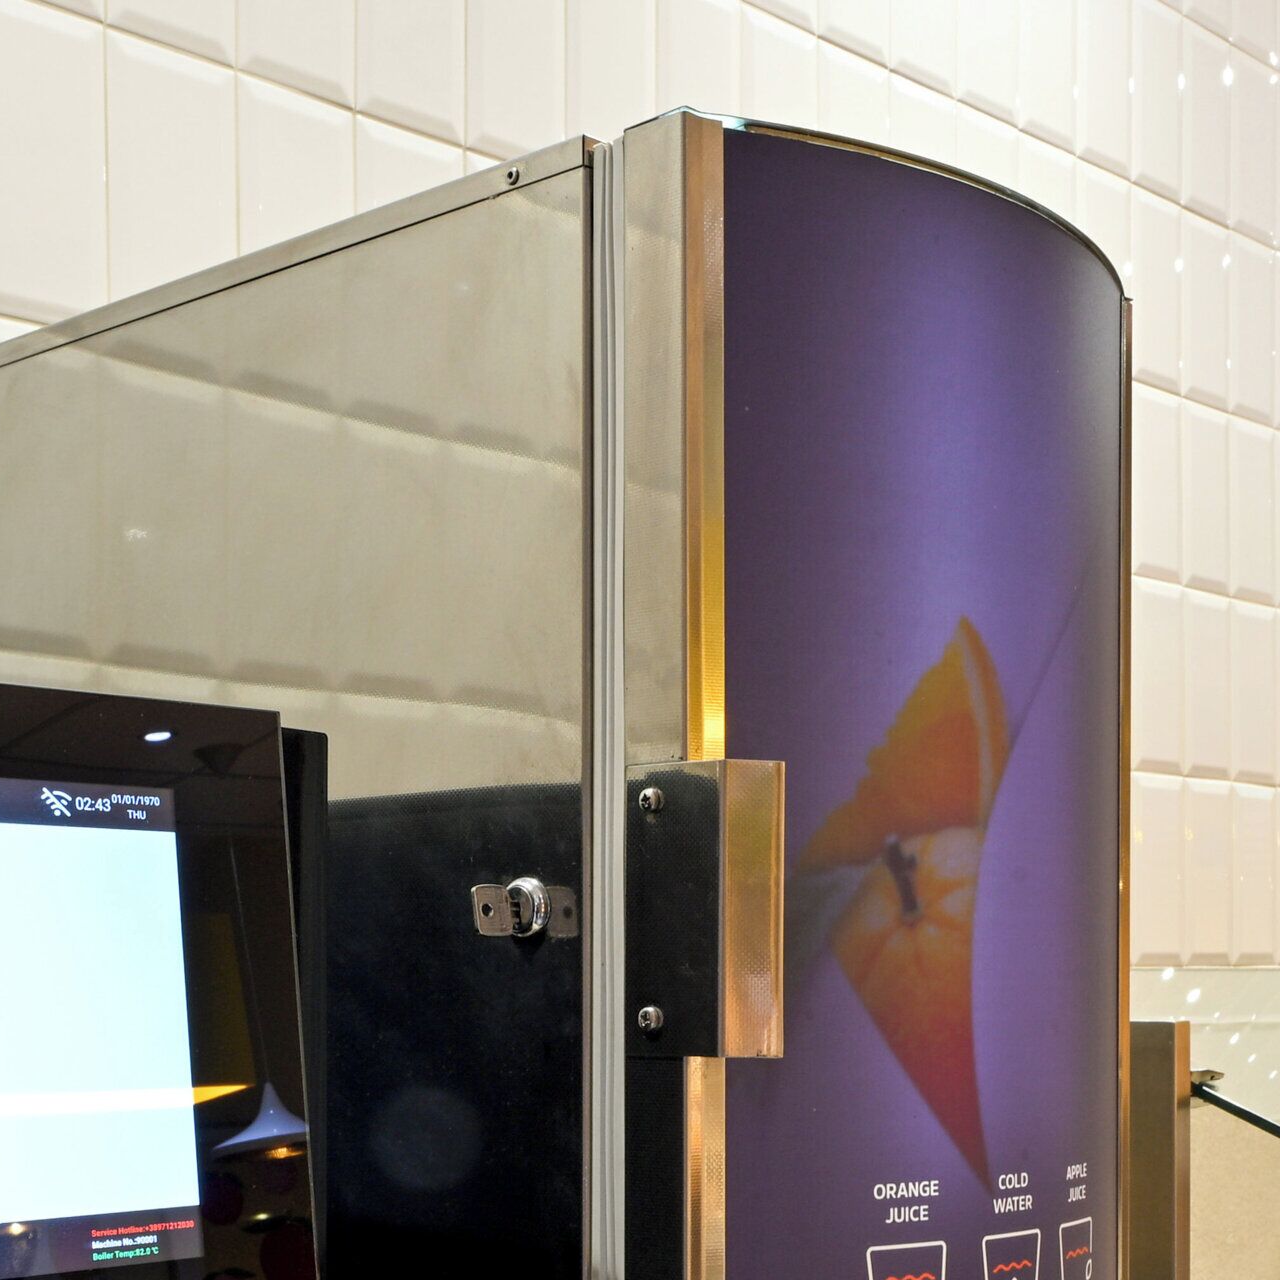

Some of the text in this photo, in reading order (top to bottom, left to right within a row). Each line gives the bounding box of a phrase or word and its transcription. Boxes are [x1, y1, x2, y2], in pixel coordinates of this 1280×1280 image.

[75, 794, 160, 812] 02:43 01/01/1970
[127, 809, 147, 820] THU
[998, 1172, 1029, 1190] COLD
[1066, 1163, 1087, 1181] APPLE
[873, 1180, 939, 1200] ORANGE
[1067, 1184, 1086, 1202] JUICE
[993, 1194, 1033, 1214] WATER
[885, 1204, 929, 1224] JUICE
[91, 1228, 118, 1238] Service
